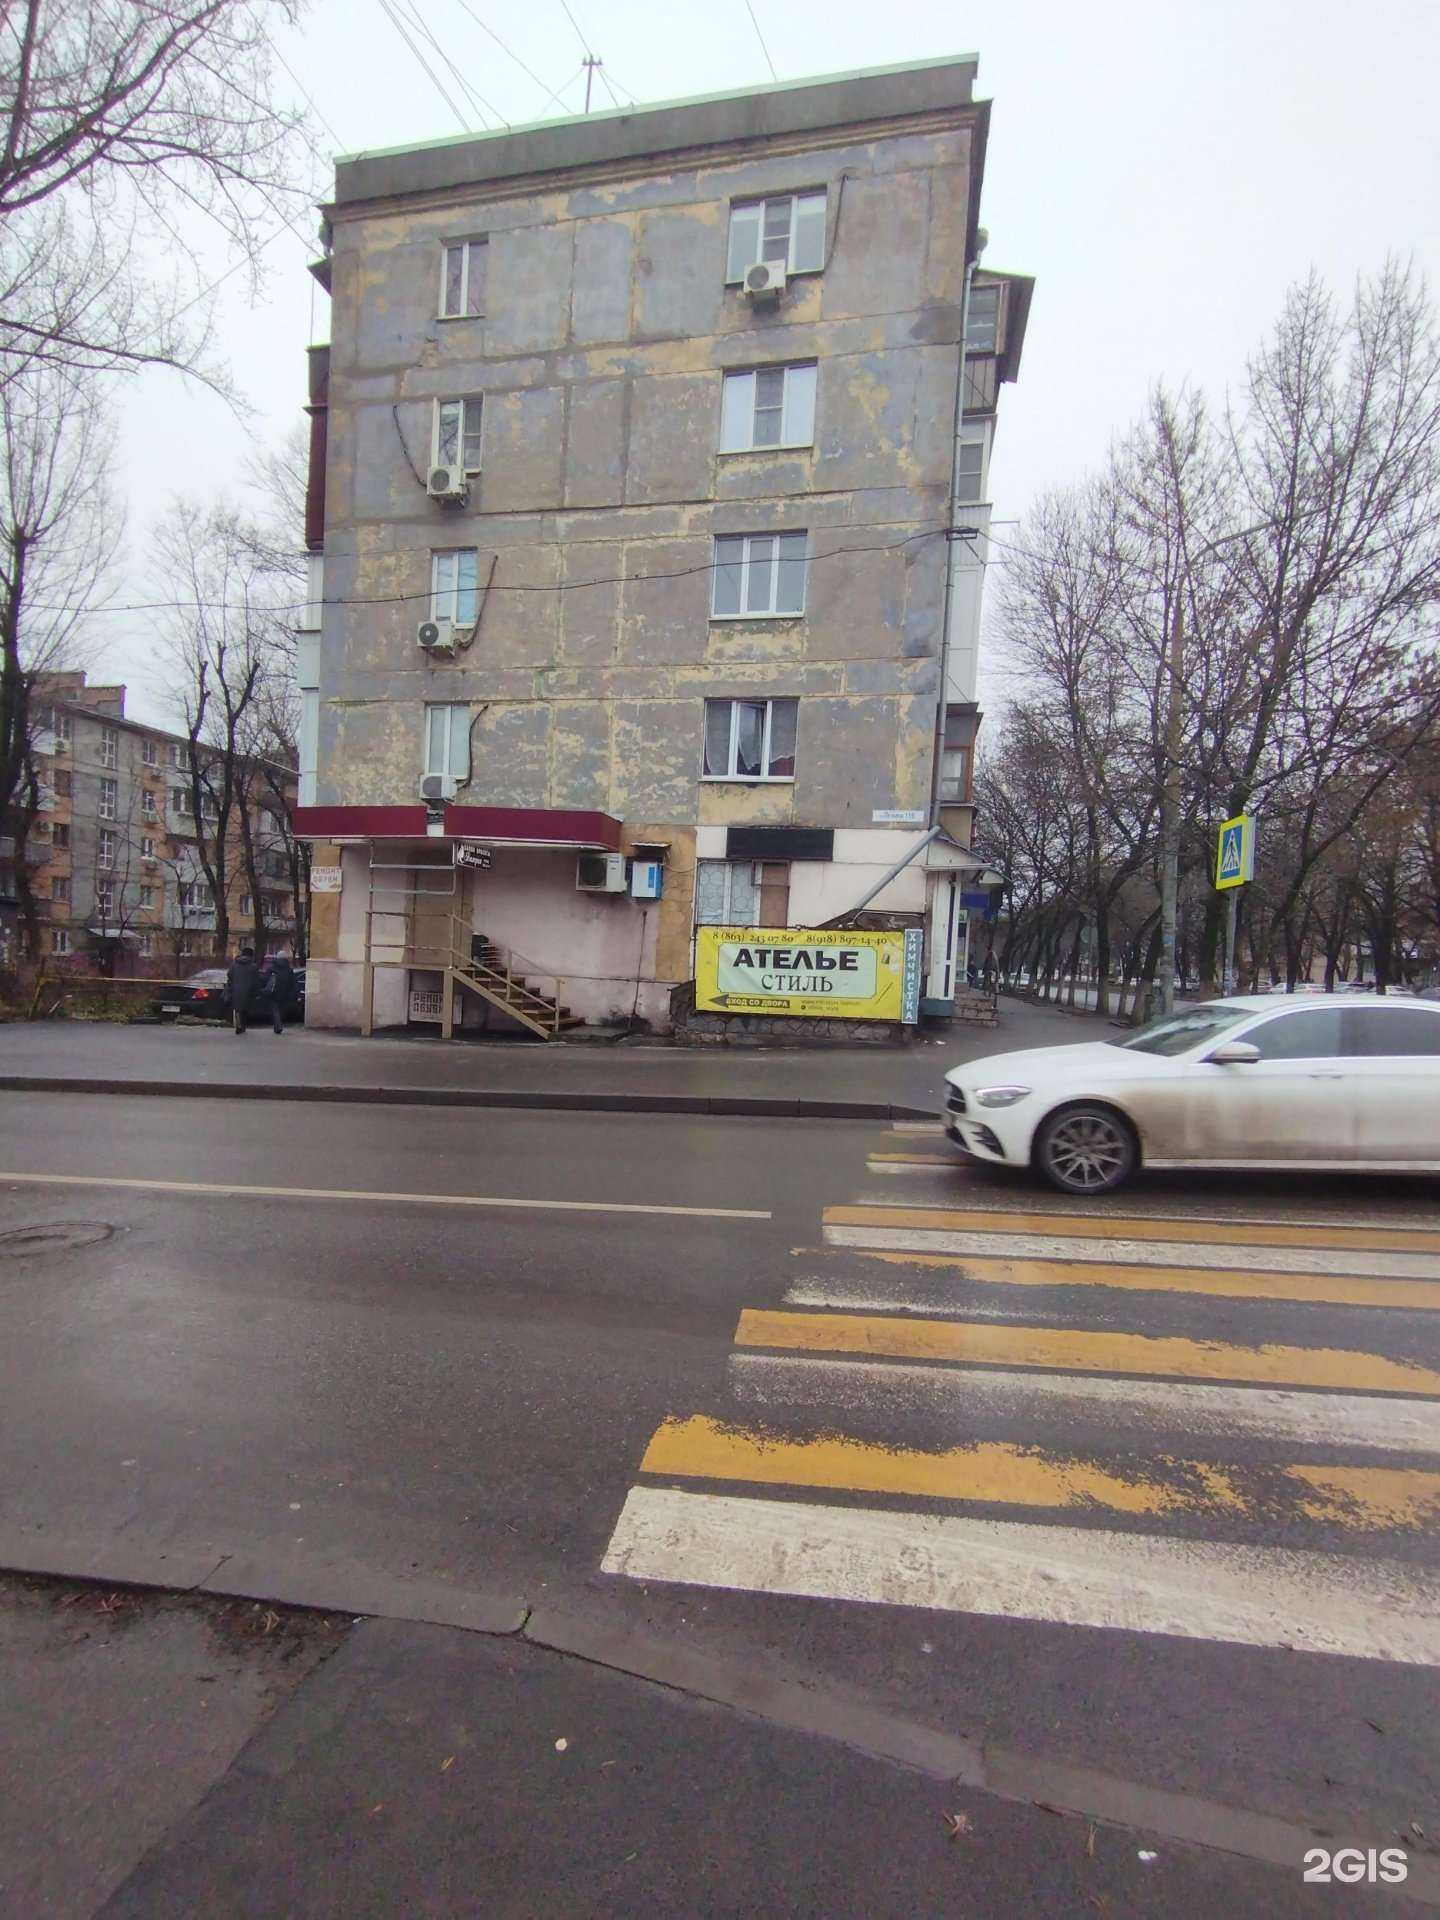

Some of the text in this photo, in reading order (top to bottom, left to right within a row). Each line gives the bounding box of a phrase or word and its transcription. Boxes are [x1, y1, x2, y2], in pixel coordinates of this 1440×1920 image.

[721, 933, 745, 942] (863)
[781, 934, 794, 943] 80
[733, 948, 859, 971] АТЕЛЬЕ
[761, 974, 833, 992] СТИЛЬ
[905, 932, 917, 1020] ХИМЧИСТКА
